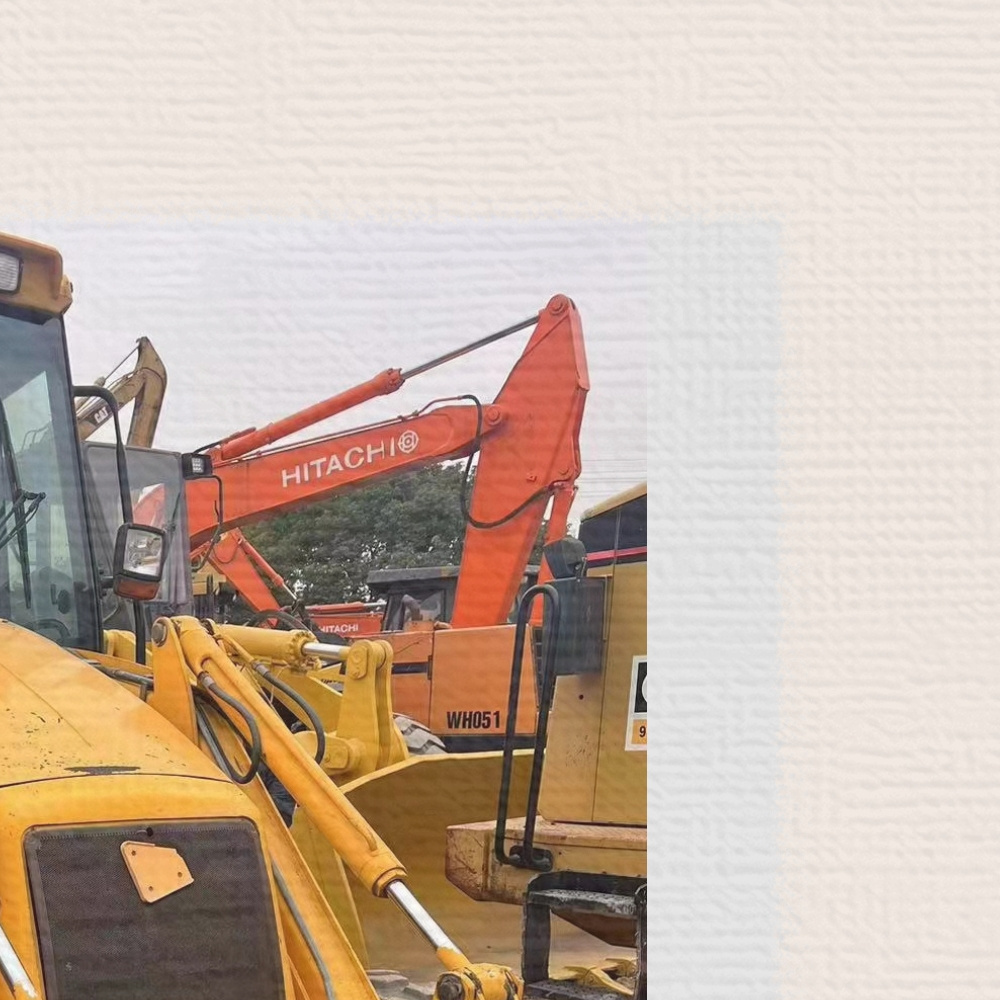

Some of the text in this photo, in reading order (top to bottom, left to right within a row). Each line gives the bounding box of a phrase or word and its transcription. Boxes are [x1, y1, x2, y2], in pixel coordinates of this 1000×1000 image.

[281, 437, 396, 488] HITACHI
[319, 624, 359, 634] HITACHI
[446, 710, 500, 729] WH051
